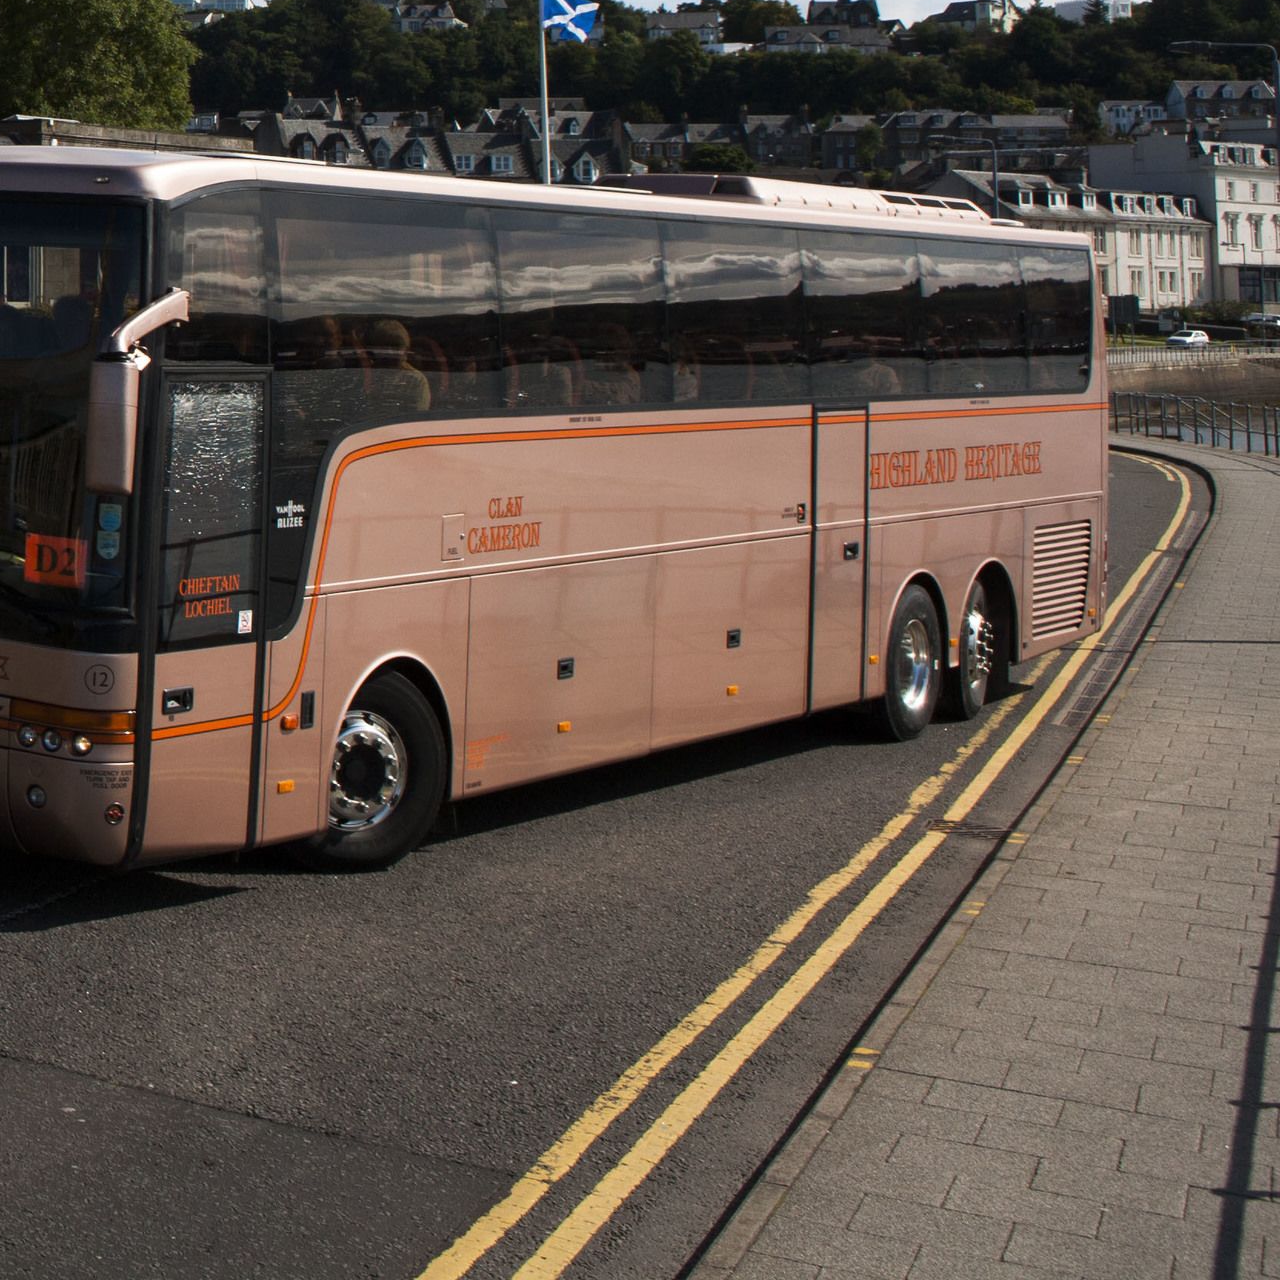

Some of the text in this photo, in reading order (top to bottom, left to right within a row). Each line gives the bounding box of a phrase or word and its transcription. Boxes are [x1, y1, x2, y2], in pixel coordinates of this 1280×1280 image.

[870, 441, 1043, 490] HIGHLAND HERITAGE
[488, 495, 524, 520] CLAN
[276, 516, 304, 529] ALIZEE
[467, 521, 542, 554] CAMERON
[35, 543, 77, 577] D2
[179, 574, 240, 596] CHIEFTAIN
[185, 597, 233, 618] LOCHIEL
[92, 672, 108, 688] 12
